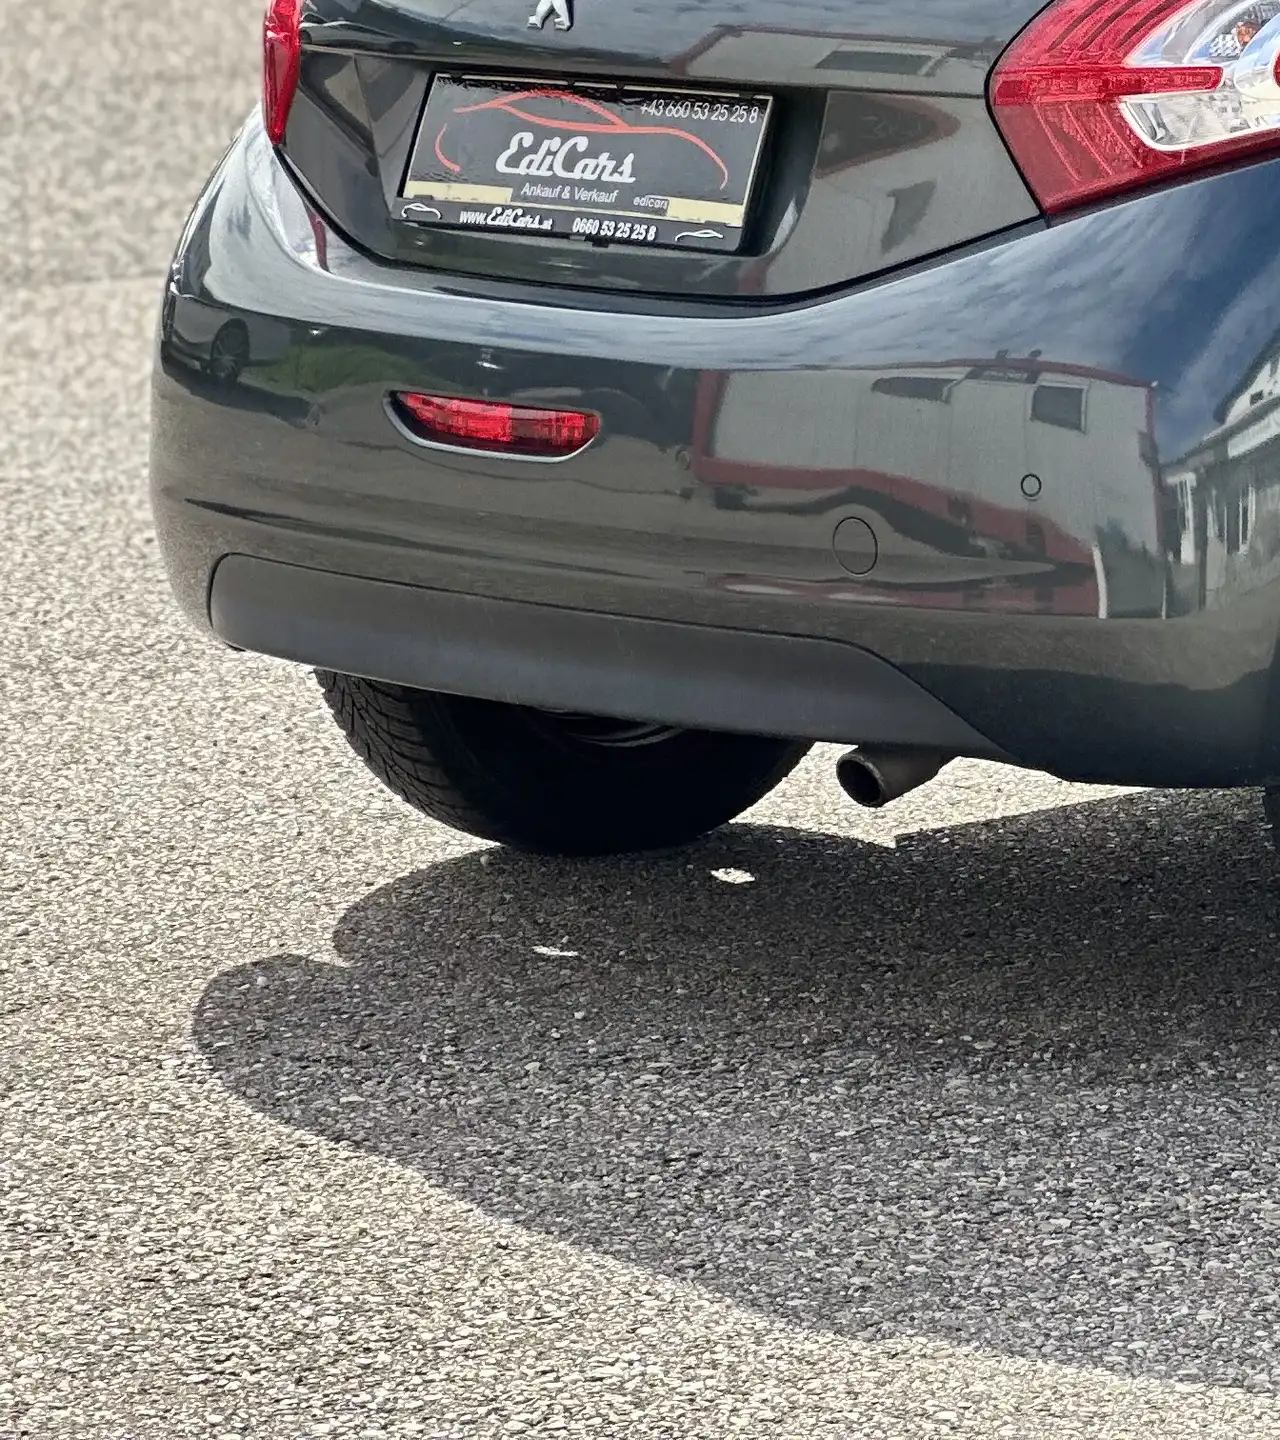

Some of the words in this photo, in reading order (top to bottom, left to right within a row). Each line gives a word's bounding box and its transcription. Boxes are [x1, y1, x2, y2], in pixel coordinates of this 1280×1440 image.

[640, 99, 665, 117] +43
[665, 101, 690, 118] 660
[692, 102, 710, 120] 53
[711, 103, 729, 121] 25
[729, 105, 748, 123] 25
[749, 106, 759, 124] 8
[495, 131, 636, 183] EdiCars
[520, 182, 562, 198] Ankauf
[561, 185, 571, 199] &
[575, 189, 619, 203] Verkauf
[572, 217, 600, 235] 0660
[600, 220, 616, 237] 53
[615, 222, 632, 238] 25
[631, 223, 648, 240] 25
[647, 225, 657, 241] 8
